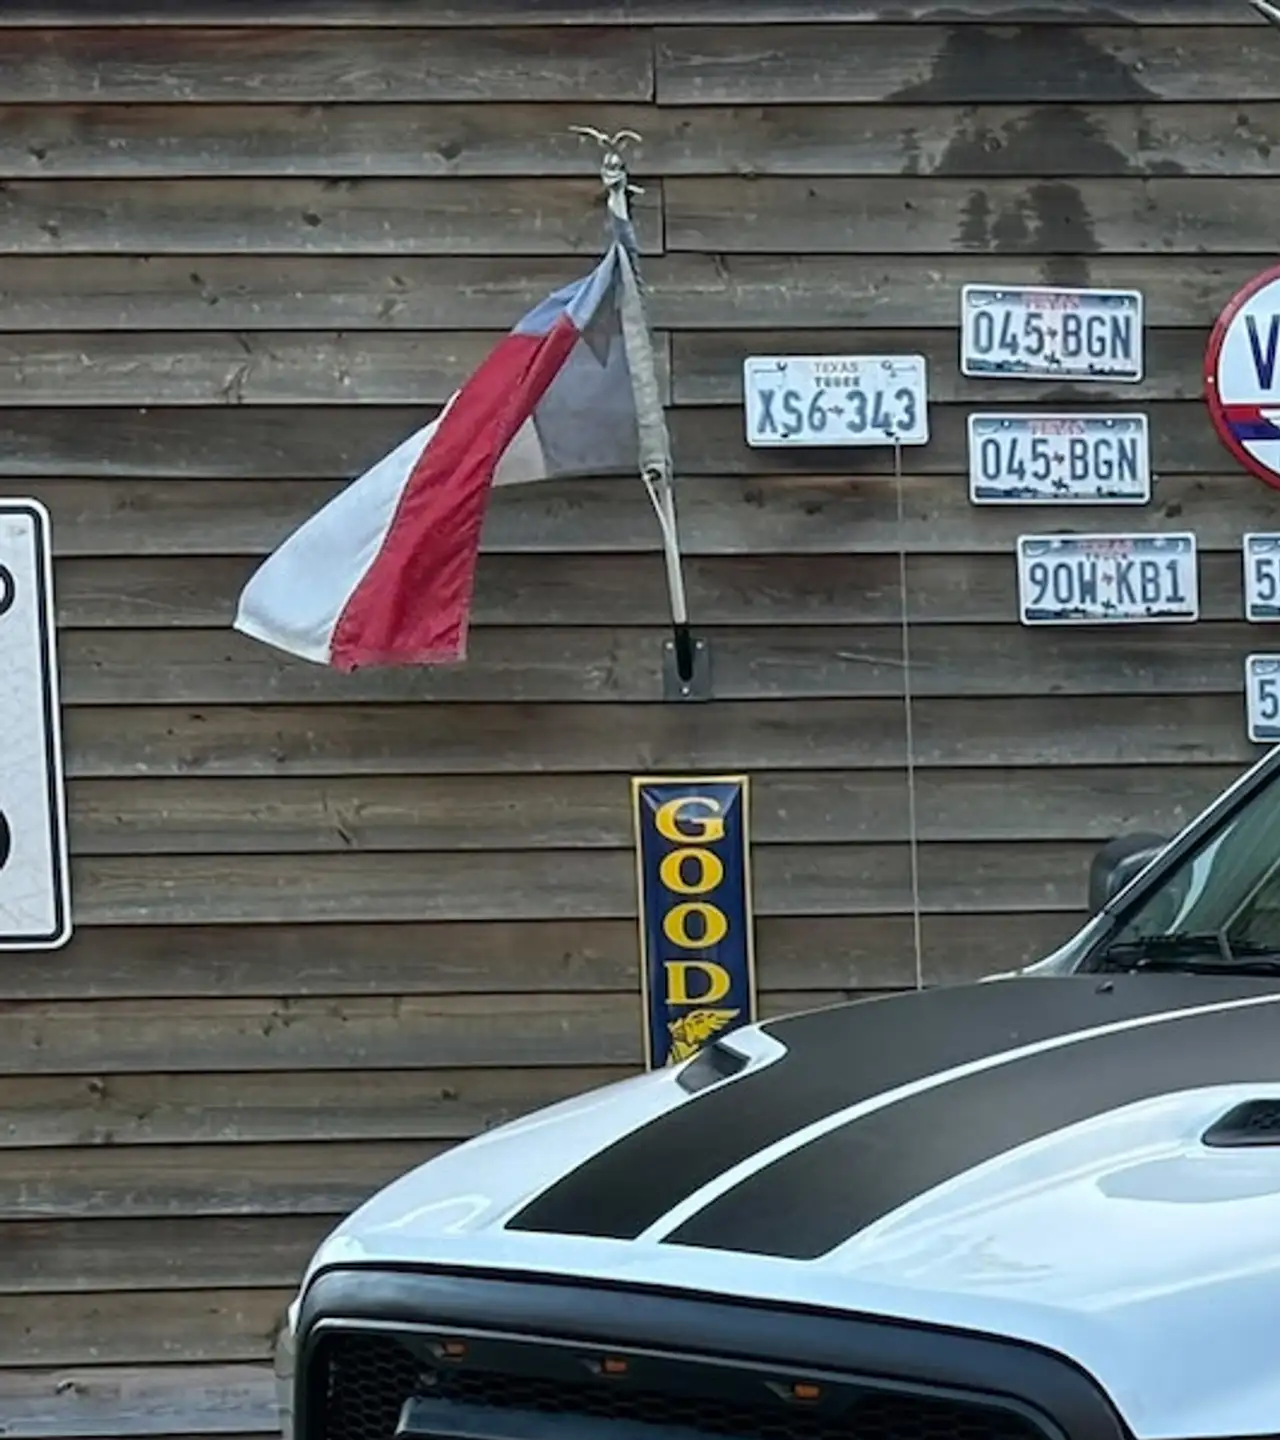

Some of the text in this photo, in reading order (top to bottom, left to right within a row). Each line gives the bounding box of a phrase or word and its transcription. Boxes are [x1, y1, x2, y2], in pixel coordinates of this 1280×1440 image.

[973, 310, 1132, 360] 045 BGN
[814, 360, 860, 374] TEXAS
[756, 387, 917, 435] XS6 343
[981, 437, 1138, 482] 045 BGN
[1115, 558, 1187, 605] KB1
[654, 796, 732, 1006] GOOD
